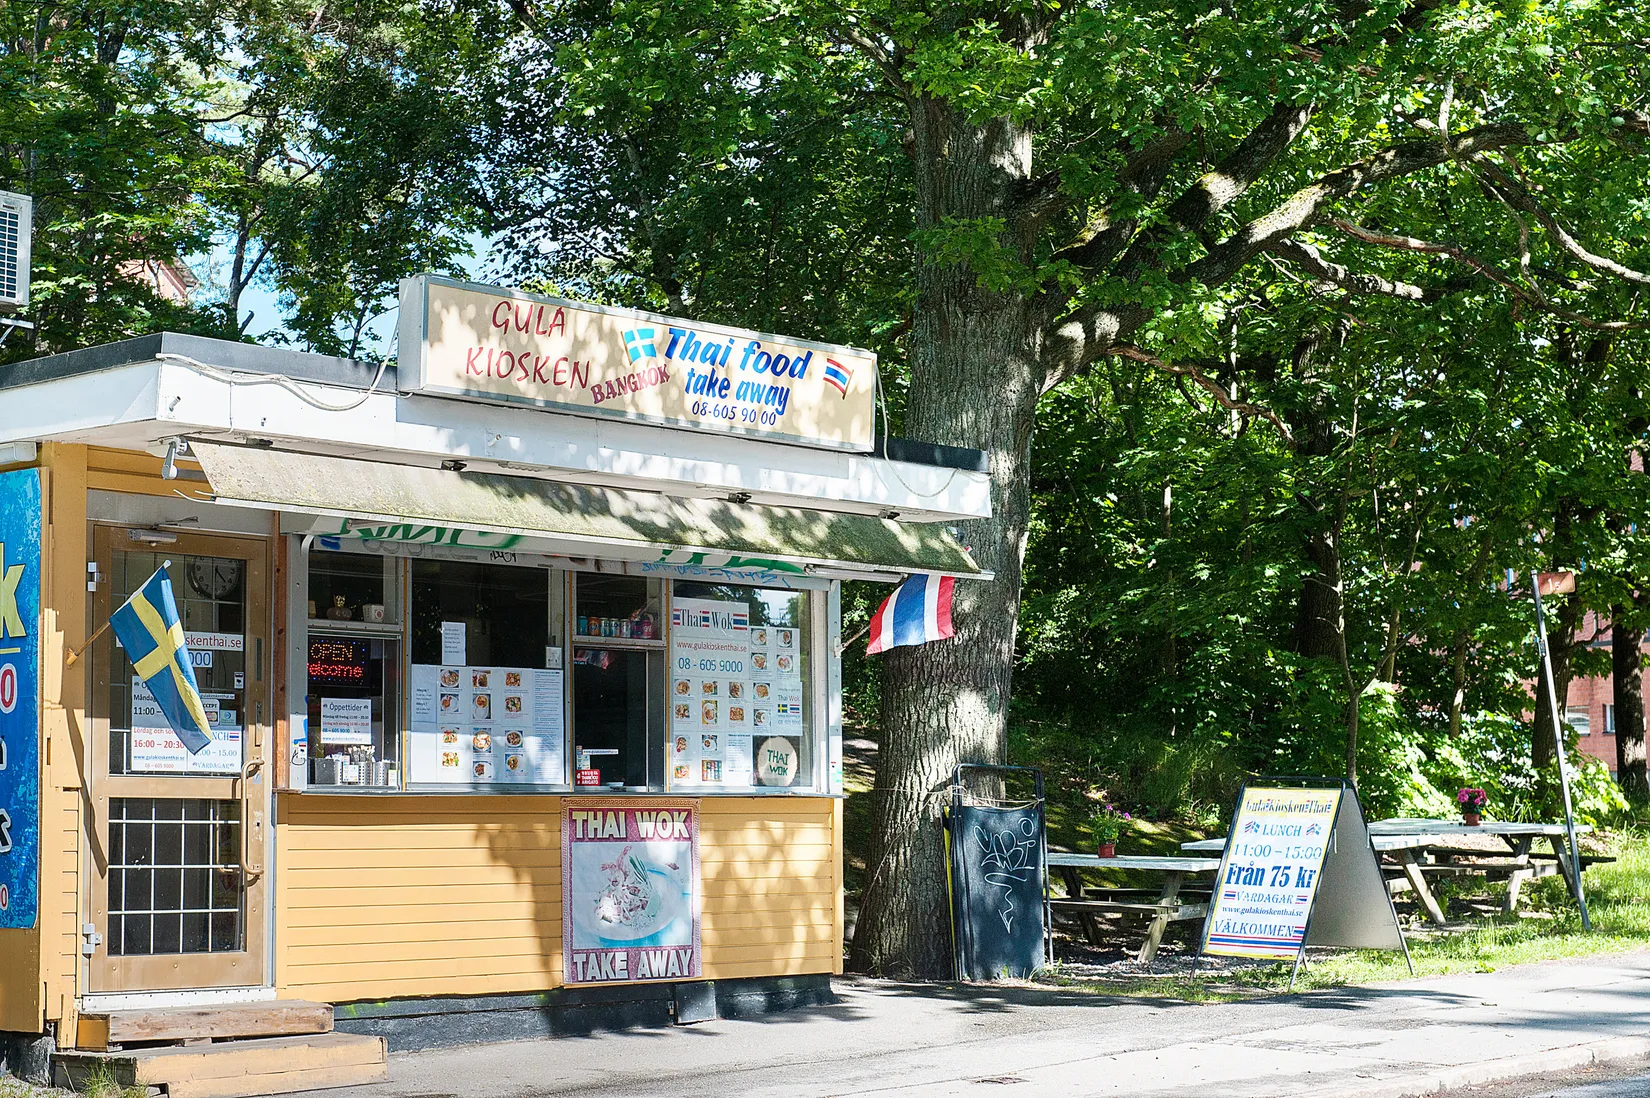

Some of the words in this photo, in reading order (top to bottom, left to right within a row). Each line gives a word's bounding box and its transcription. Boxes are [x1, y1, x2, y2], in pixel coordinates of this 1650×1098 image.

[491, 301, 566, 337] GULA
[665, 327, 735, 368] Thai
[739, 341, 814, 380] food
[466, 346, 590, 390] KIOSKEN
[591, 363, 671, 404] BANGKOK
[685, 368, 731, 400] take
[736, 379, 790, 416] away
[692, 401, 737, 420] 08-605
[680, 609, 702, 628] Thai
[711, 611, 733, 630] Wok
[185, 633, 242, 649] skenthai.se
[676, 642, 747, 652] www.gulakioskenthai.se
[189, 652, 212, 663] 000
[310, 643, 353, 661] OPEN
[678, 657, 691, 670] 08
[700, 659, 717, 671] 605
[719, 660, 743, 673] 9000
[133, 706, 155, 715] 11:00
[329, 702, 363, 712] Öppettider
[134, 739, 156, 748] 16:00
[212, 731, 229, 741] NCH
[767, 749, 790, 766] THAI
[769, 764, 789, 777] WOK
[572, 810, 628, 839] THAI
[635, 810, 690, 839] WOK
[1261, 824, 1302, 838] LUNCH
[1234, 843, 1272, 856] 11:00
[1224, 860, 1266, 886] Från
[1269, 865, 1291, 887] 75
[1236, 891, 1294, 905] VARDAGAR
[1221, 905, 1304, 917] www.gulakioskenthai.se
[1213, 919, 1294, 937] VÄLKOMMEN
[572, 951, 631, 982] TAKE
[636, 950, 692, 979] AWAY
